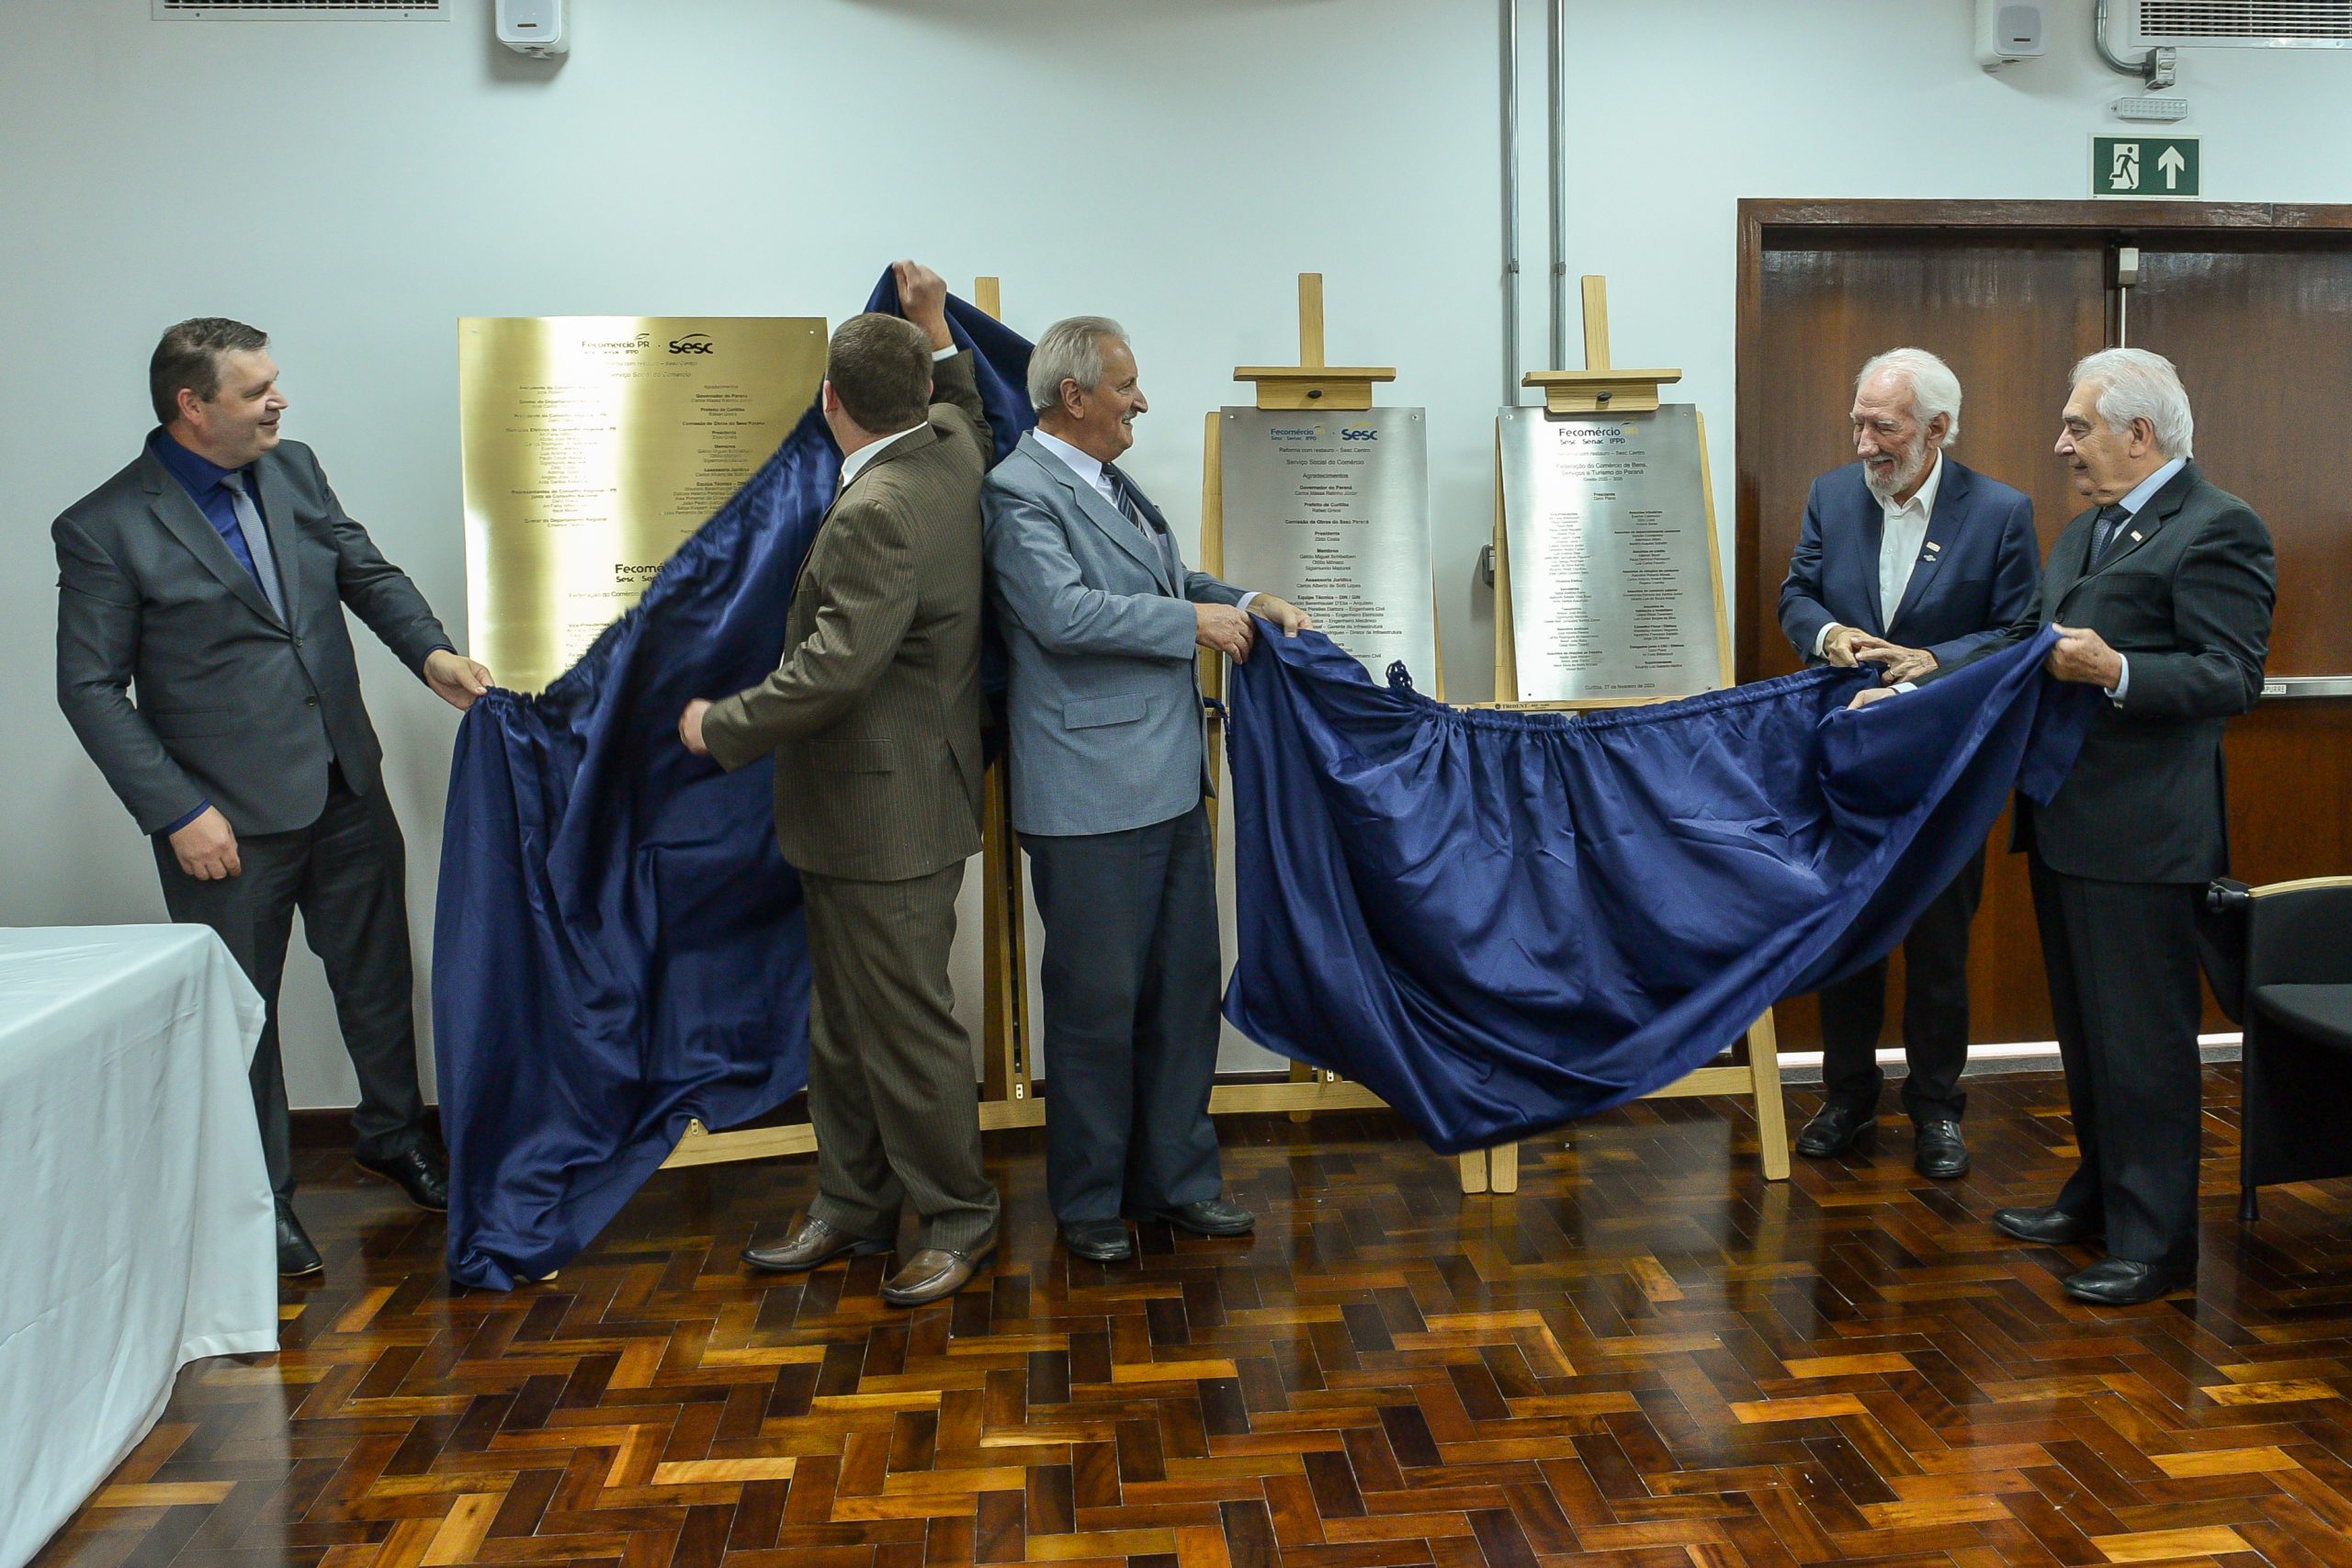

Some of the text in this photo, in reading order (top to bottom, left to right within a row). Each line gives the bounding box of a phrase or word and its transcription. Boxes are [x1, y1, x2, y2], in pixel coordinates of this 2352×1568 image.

[669, 340, 714, 355] Sesc
[1341, 429, 1378, 441] Sesc
[1559, 426, 1621, 436] Fecomércio
[615, 563, 664, 574] Fecomé
[2265, 685, 2286, 694] PURRE
